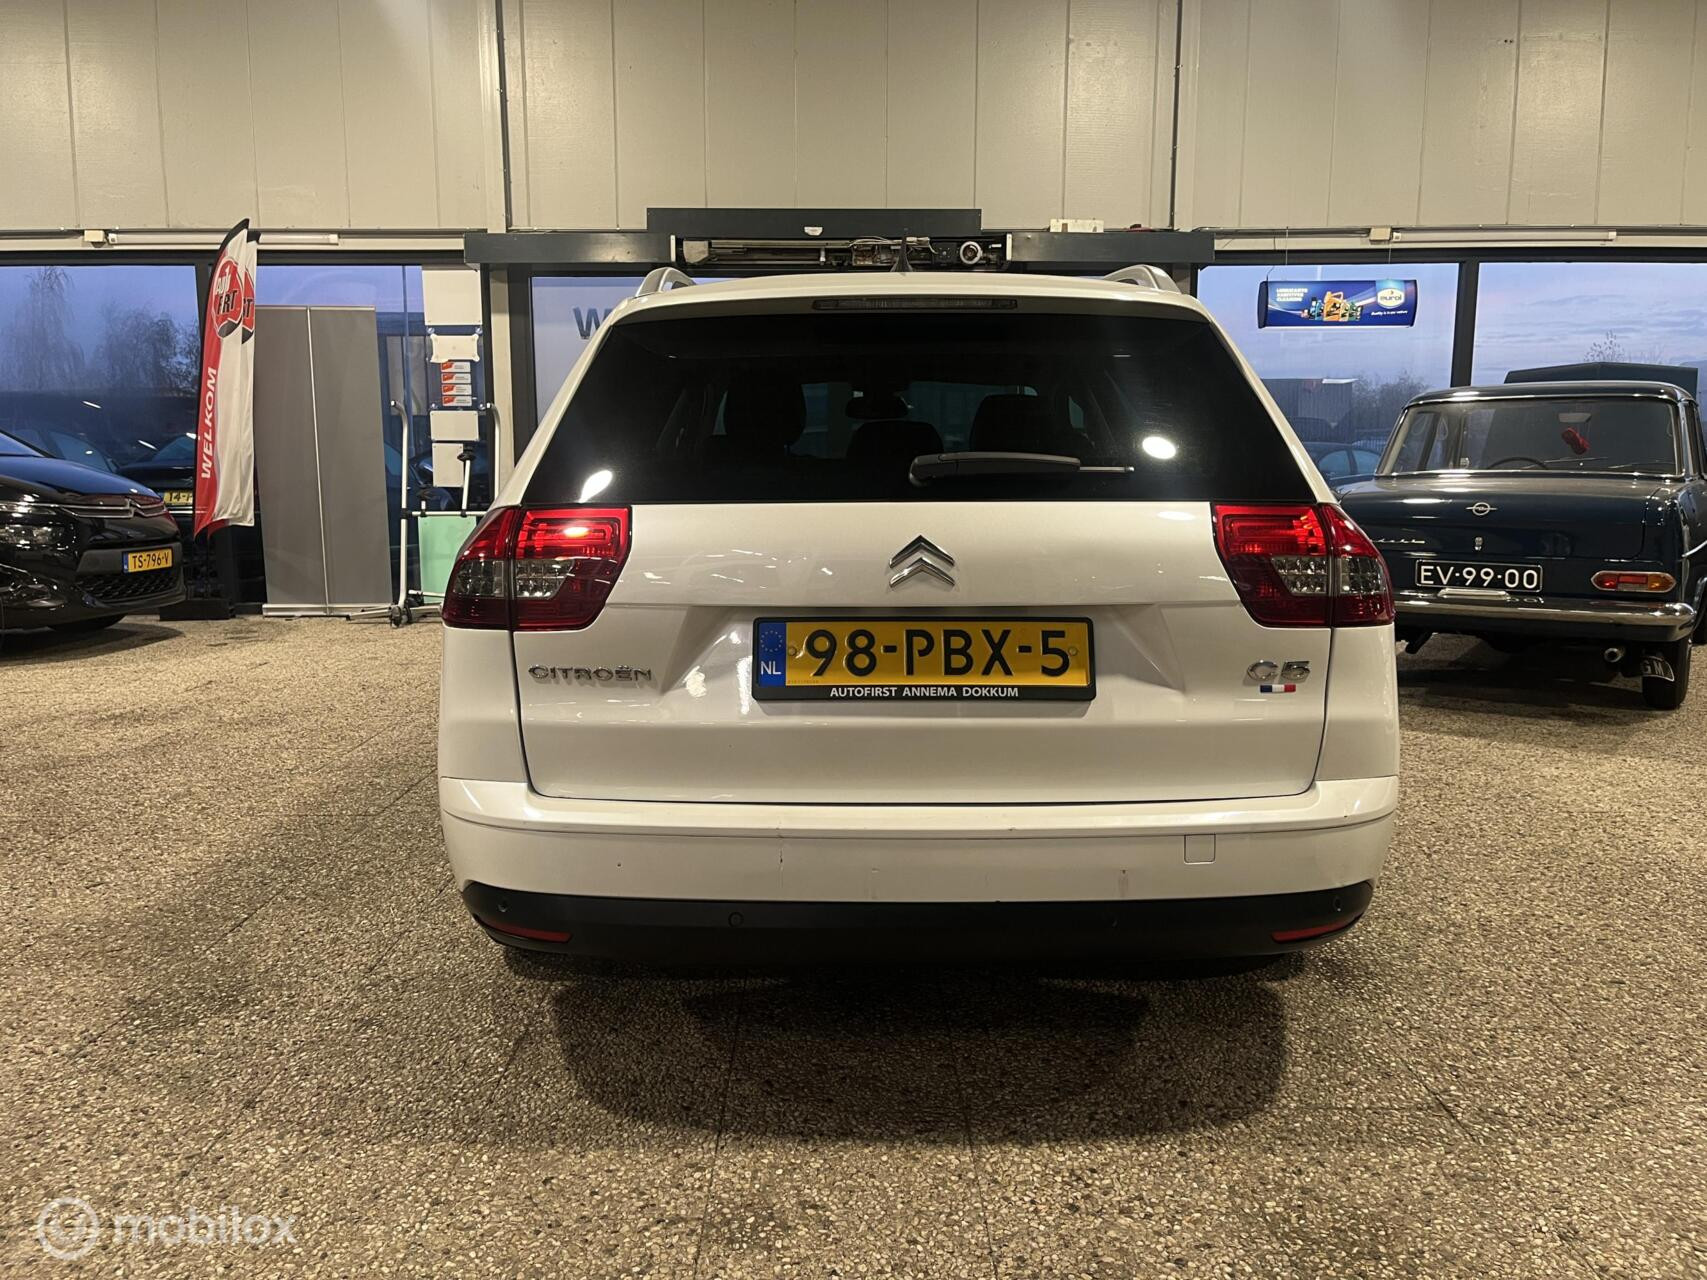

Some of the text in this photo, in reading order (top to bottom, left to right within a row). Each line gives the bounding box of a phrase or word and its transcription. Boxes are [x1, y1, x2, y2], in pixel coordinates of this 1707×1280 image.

[201, 367, 217, 479] WELKOM
[132, 551, 169, 569] TS-796-V
[803, 629, 1071, 677] 98-PBX-5
[528, 664, 652, 681] CITROËN
[760, 660, 782, 675] NL
[1246, 659, 1311, 681] C5
[830, 687, 1019, 697] AUTOFIRST ANNEMA DOKKUM
